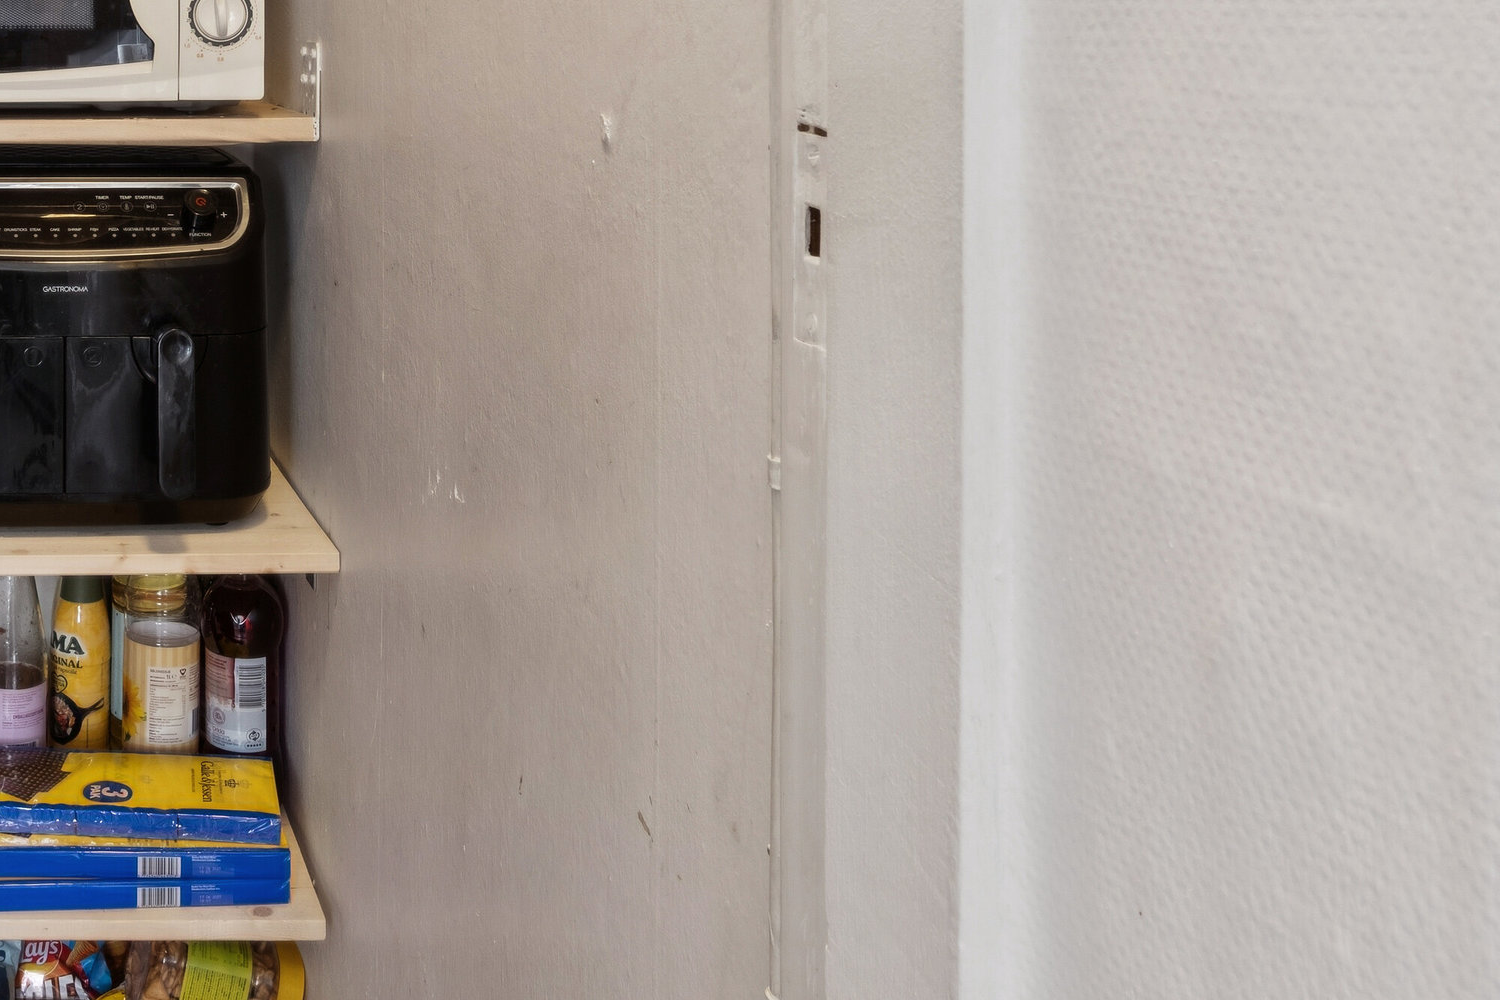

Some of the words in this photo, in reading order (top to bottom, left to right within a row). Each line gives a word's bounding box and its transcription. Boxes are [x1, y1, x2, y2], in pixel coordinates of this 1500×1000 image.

[52, 630, 85, 656] MA
[52, 654, 83, 669] GINAL
[89, 784, 101, 799] PAK
[101, 786, 129, 799] 3
